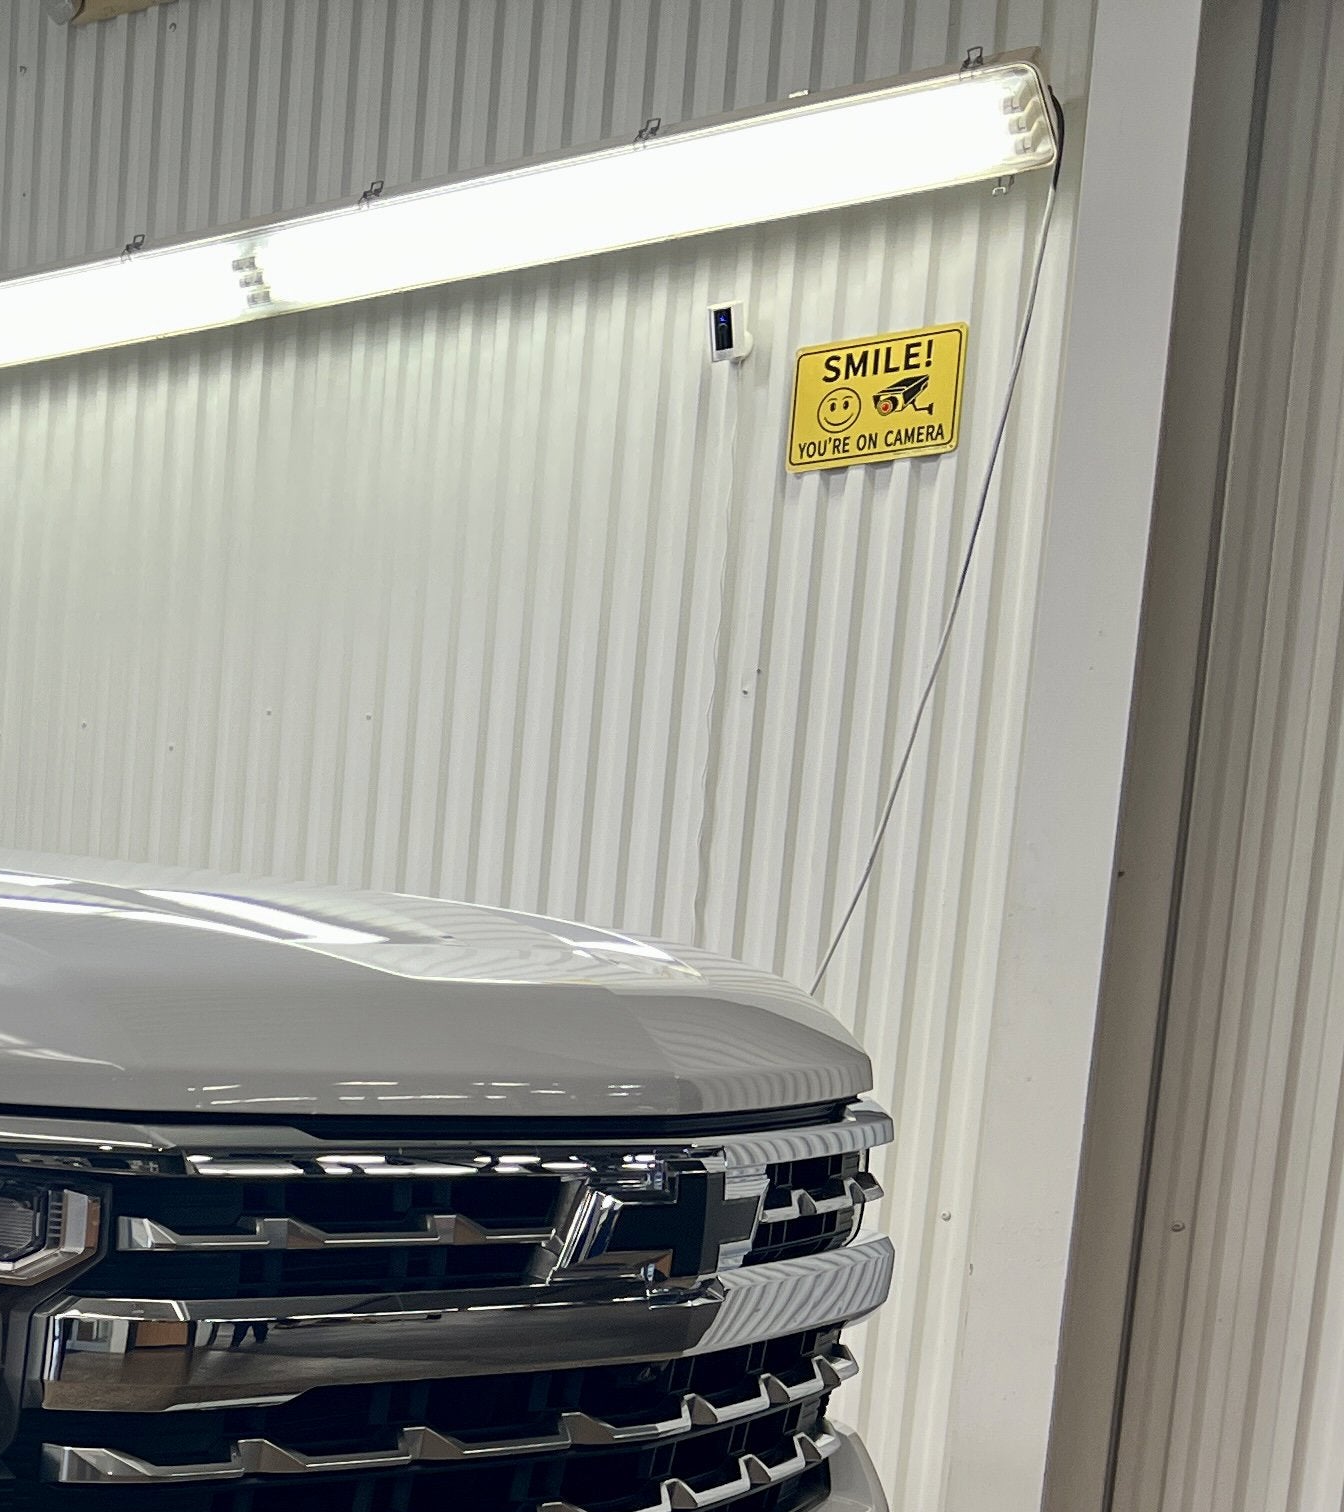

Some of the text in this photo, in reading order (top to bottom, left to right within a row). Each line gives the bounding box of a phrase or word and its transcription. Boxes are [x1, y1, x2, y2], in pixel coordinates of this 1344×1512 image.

[821, 339, 934, 383] SMILE!
[798, 436, 851, 460] YOU'RE
[856, 432, 878, 452] ON
[884, 423, 945, 447] CAMERA
